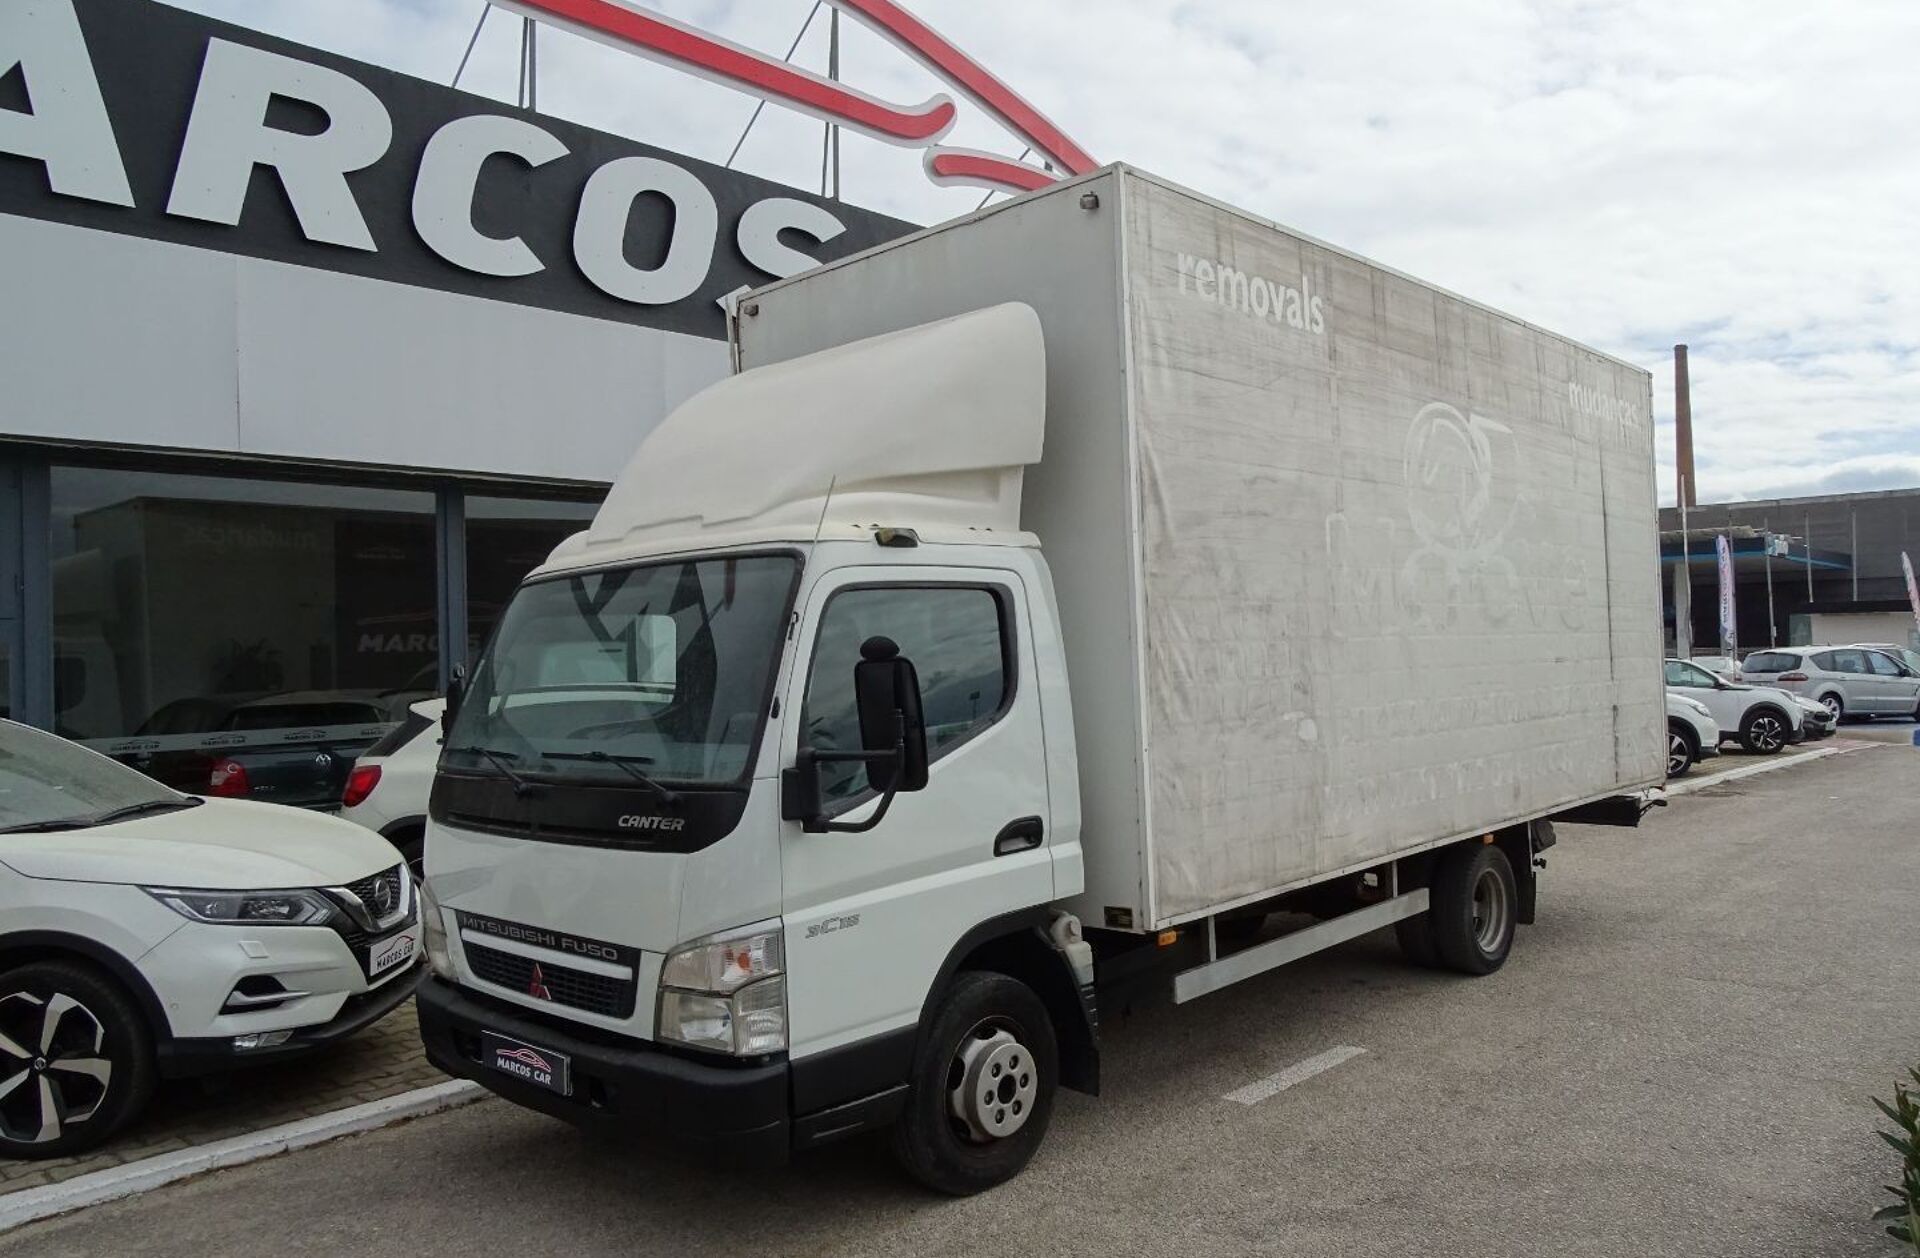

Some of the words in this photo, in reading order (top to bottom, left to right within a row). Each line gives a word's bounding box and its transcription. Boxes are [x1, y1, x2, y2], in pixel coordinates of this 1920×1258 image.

[1177, 251, 1325, 335] removals
[618, 815, 685, 831] CANTER
[463, 916, 556, 946] MITSUBISHI
[561, 938, 618, 961] FUSO
[376, 947, 403, 970] MARCOS
[403, 941, 414, 956] CAR
[496, 1056, 532, 1078] MARCOS
[534, 1070, 552, 1085] CAR
